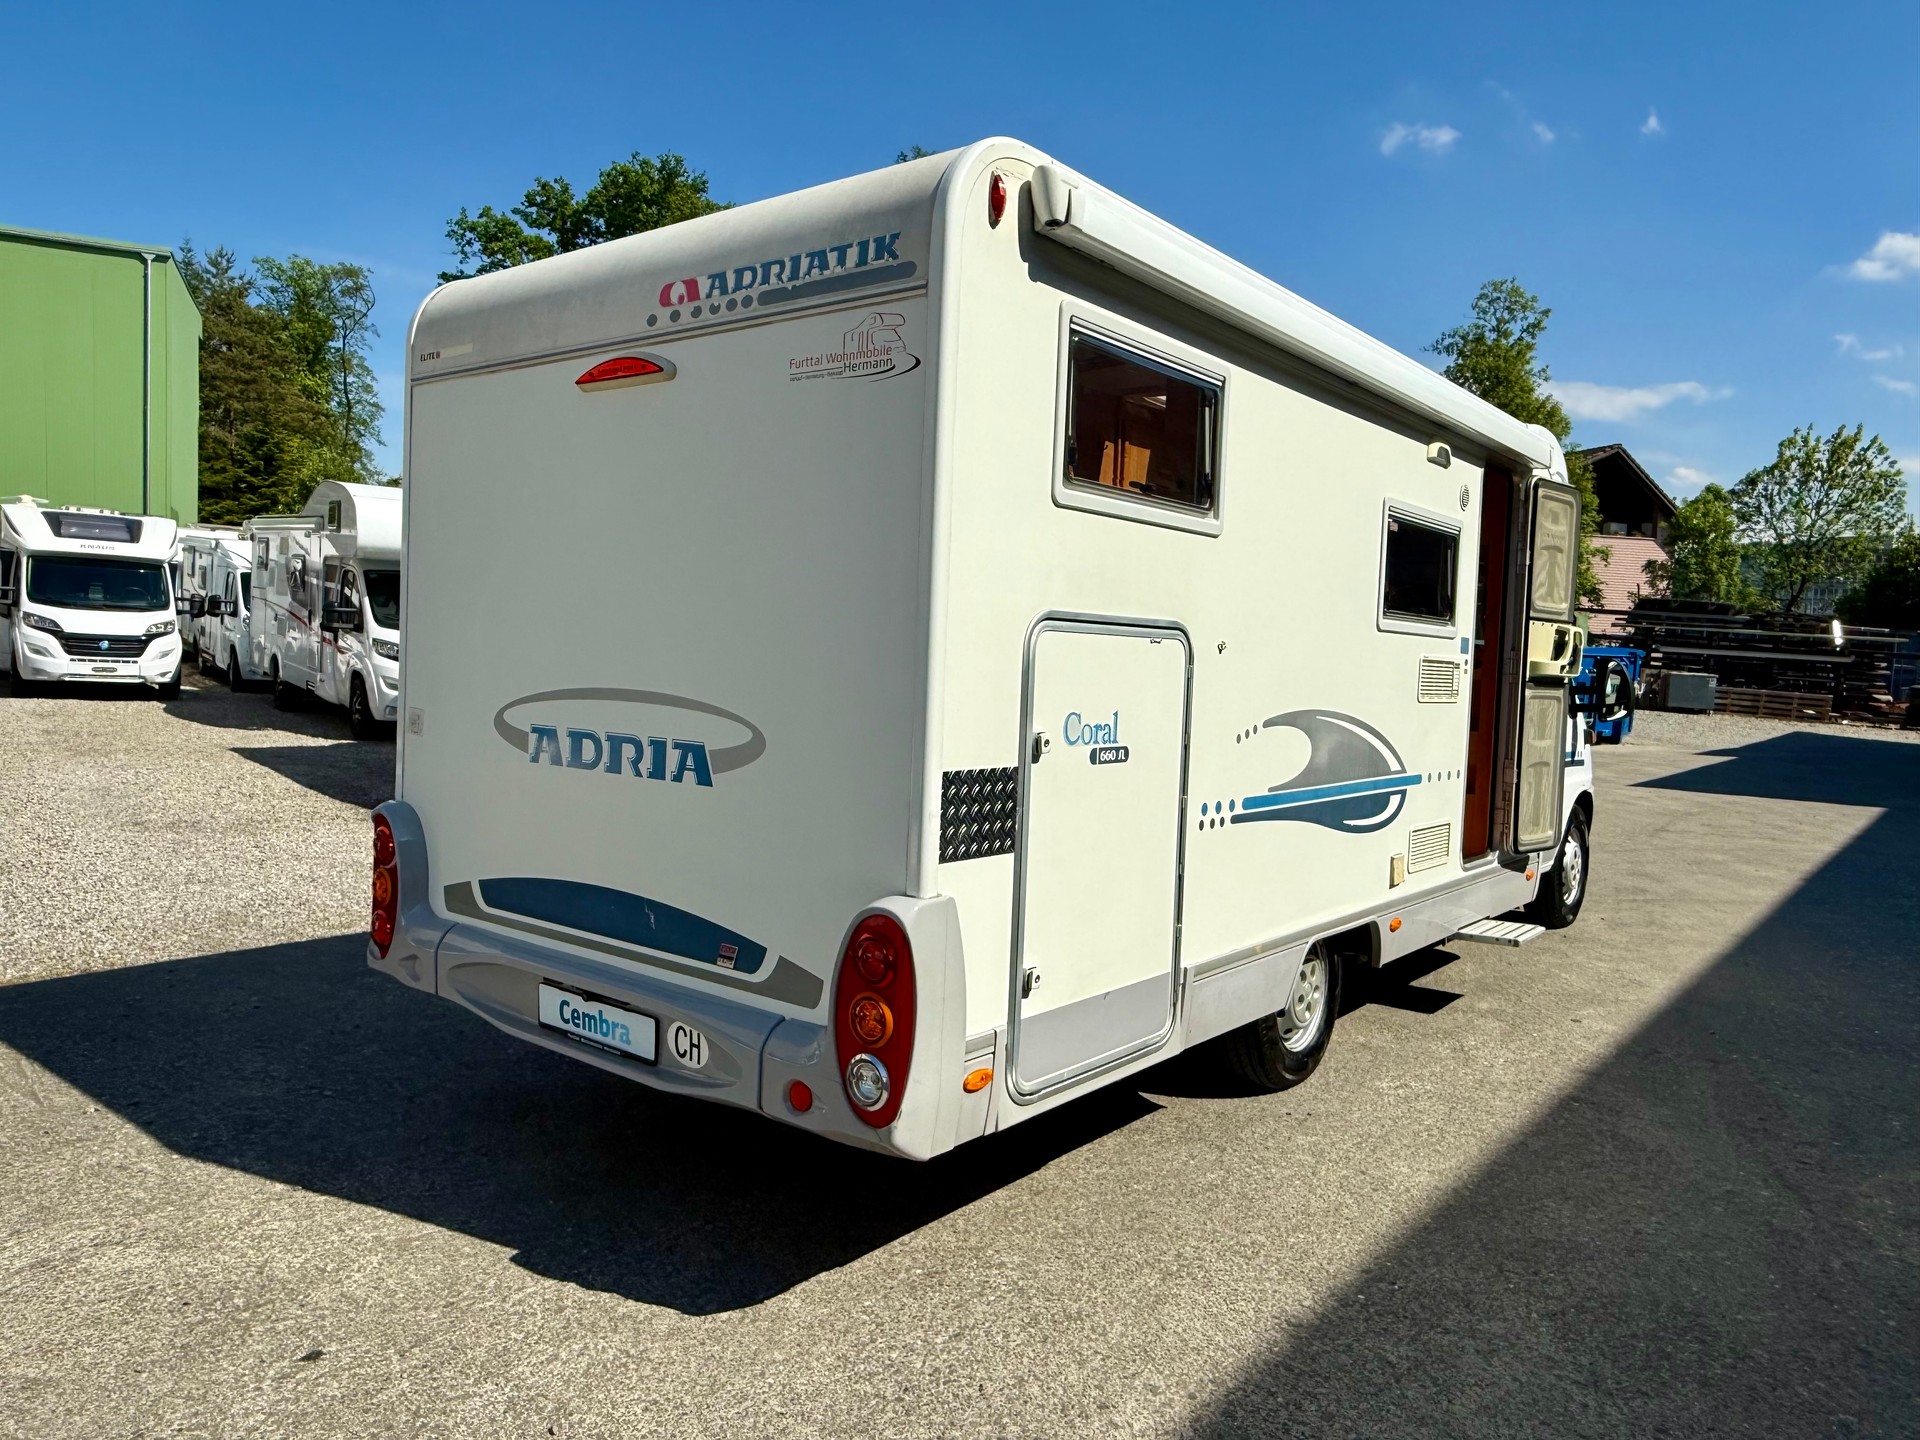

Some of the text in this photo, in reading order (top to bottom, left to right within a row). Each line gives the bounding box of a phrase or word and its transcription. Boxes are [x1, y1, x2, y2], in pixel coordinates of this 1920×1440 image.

[705, 231, 901, 299] ADRIATIK
[789, 345, 893, 370] Furttal Wohnmobile
[843, 358, 893, 373] Hermann
[1063, 710, 1119, 746] Coral
[528, 723, 714, 788] ADRIA
[1100, 749, 1116, 761] 660
[559, 999, 632, 1046] Cembra
[674, 1025, 701, 1066] CH
